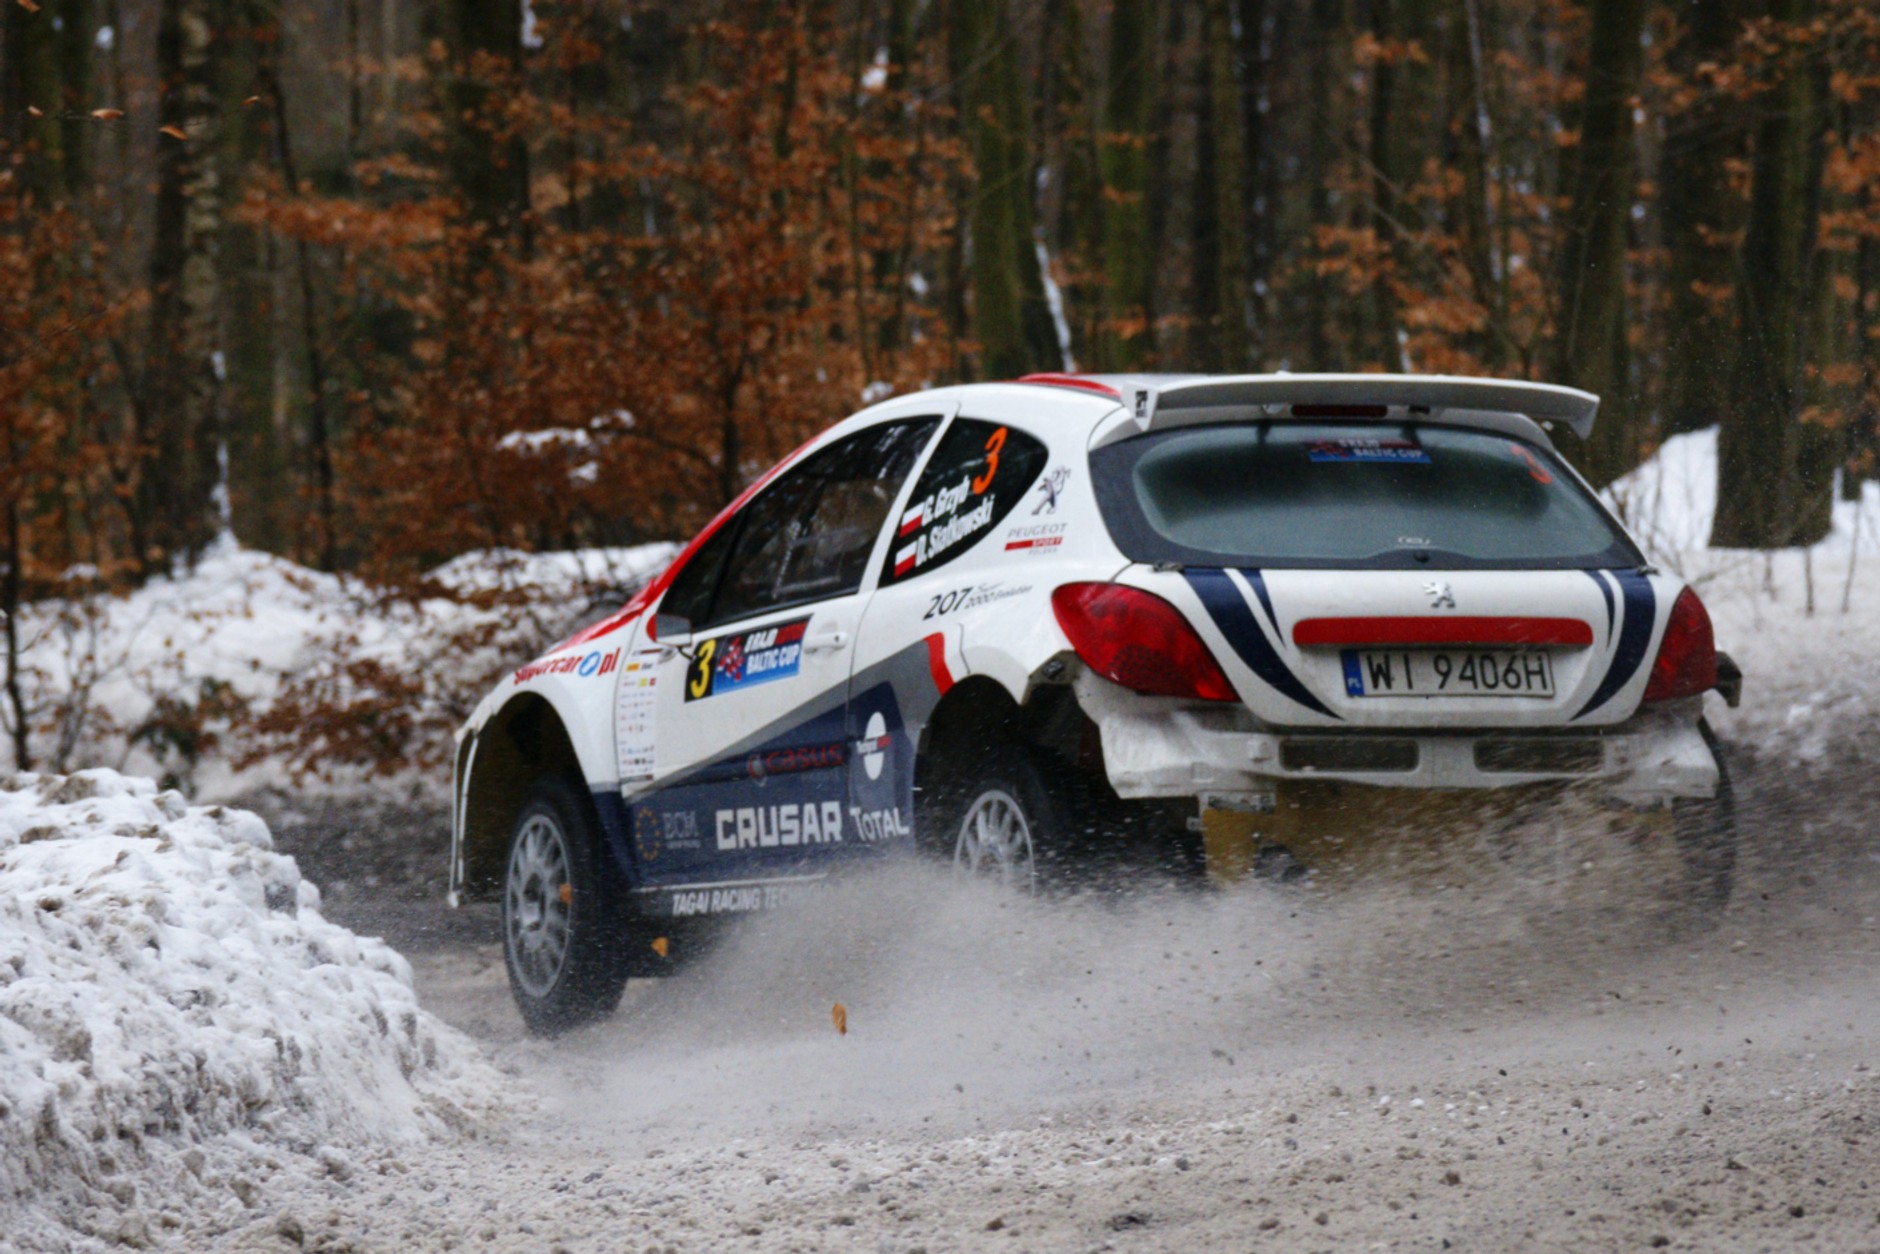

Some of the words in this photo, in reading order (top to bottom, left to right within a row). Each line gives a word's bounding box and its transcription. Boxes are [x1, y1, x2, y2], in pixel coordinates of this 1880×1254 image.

[972, 426, 1008, 495] 3
[1008, 523, 1068, 538] PEUGEOT
[1032, 536, 1063, 547] SPORT
[922, 586, 974, 621] 207
[690, 638, 716, 698] 3
[746, 647, 779, 675] BALTIC
[778, 643, 800, 668] CUP
[1366, 654, 1413, 690] WI
[1433, 654, 1548, 690] 9406H
[766, 744, 844, 774] casus
[715, 801, 843, 850] CRUSAR
[849, 807, 911, 842] TOTAL
[710, 885, 760, 913] RACING
